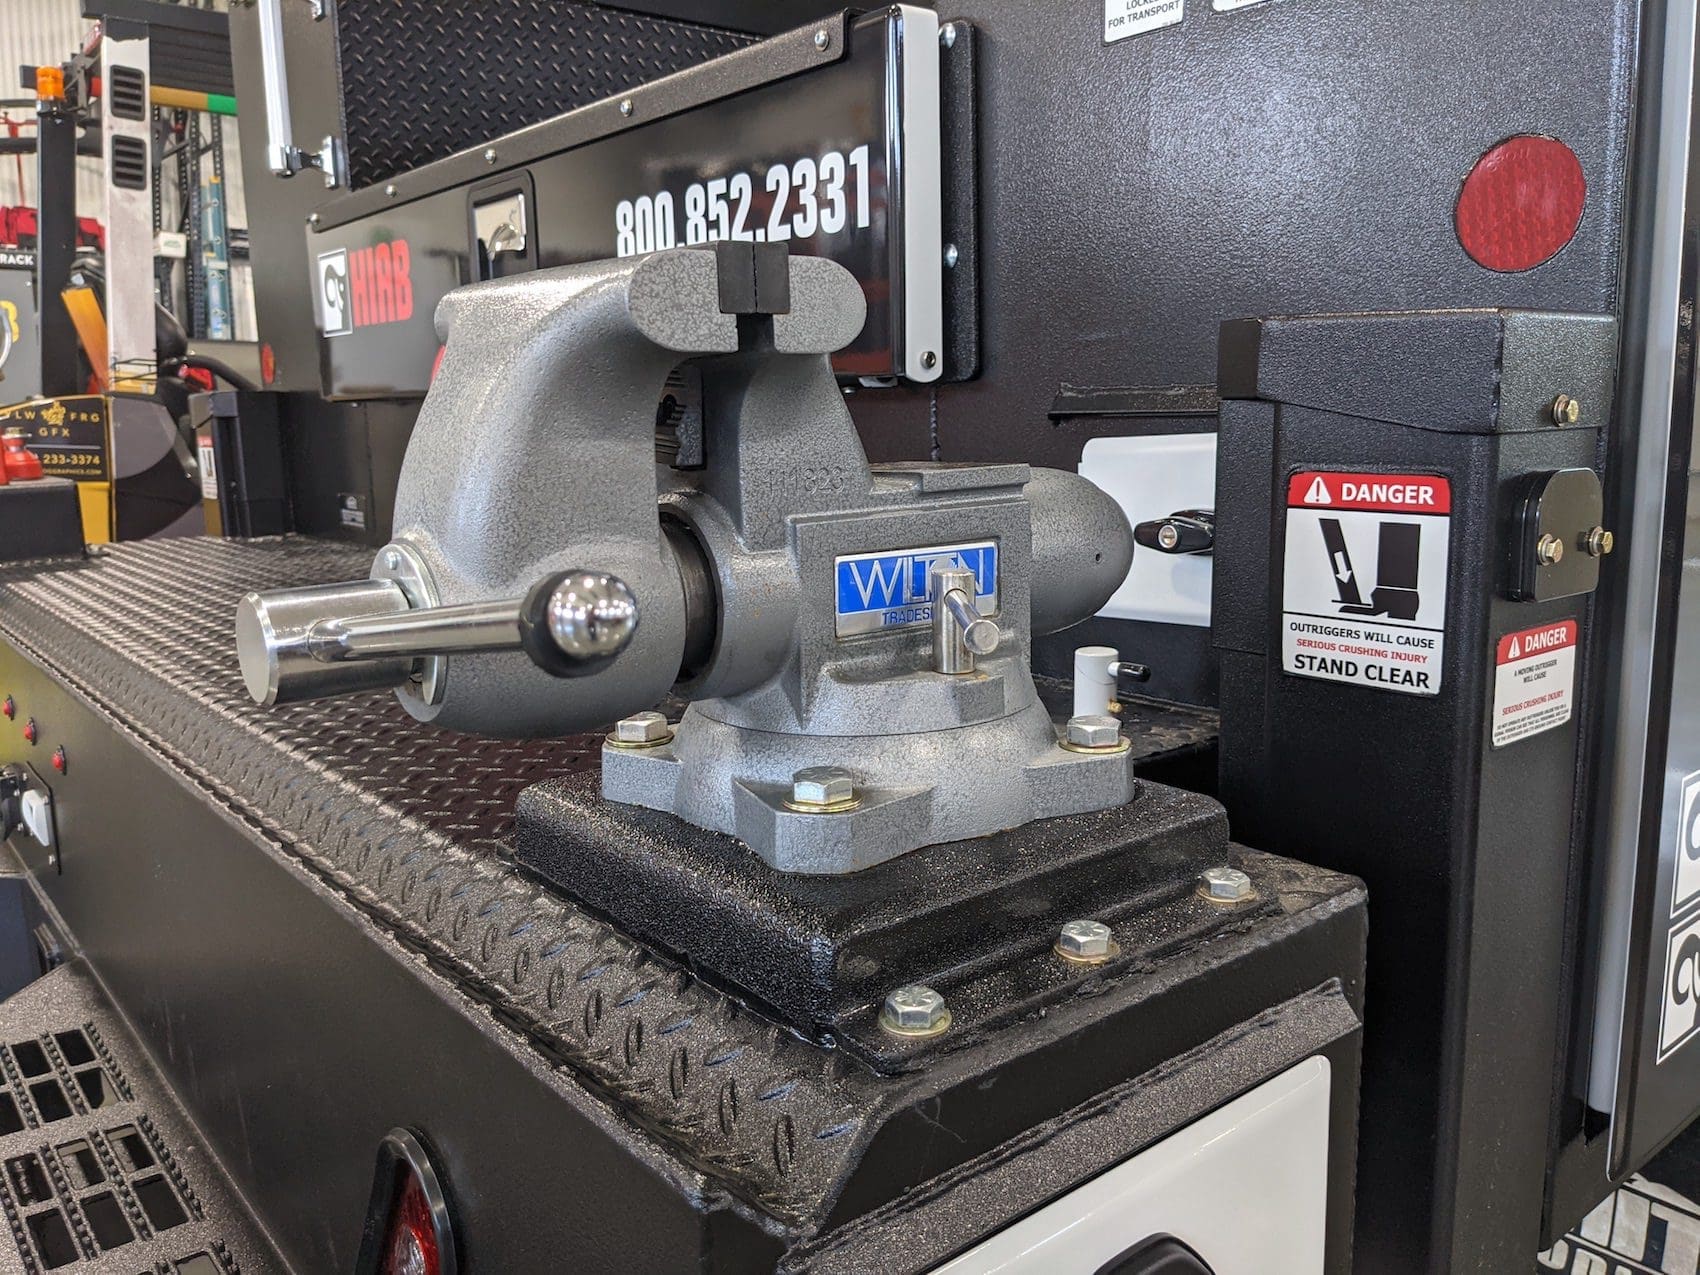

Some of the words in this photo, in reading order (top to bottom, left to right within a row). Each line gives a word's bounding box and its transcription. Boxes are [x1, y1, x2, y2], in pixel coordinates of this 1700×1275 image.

[1108, 16, 1125, 28] FOR
[1127, 1, 1179, 22] TRANSPORT
[349, 239, 413, 327] HIAB
[1341, 482, 1434, 505] DANGER
[849, 549, 984, 609] WILTN
[882, 606, 933, 625] TRADES
[1290, 622, 1361, 640] OUTRIGGERS
[1364, 631, 1393, 644] WILL
[1396, 635, 1435, 649] CAUSE
[1524, 627, 1567, 652] DANGER
[1296, 638, 1336, 651] SERIOUS
[1338, 644, 1388, 659] CRUSHING
[1391, 651, 1428, 664] INJURY
[1294, 654, 1358, 677] STAND
[1364, 664, 1430, 689] CLEAR
[1502, 702, 1523, 715] SERIOUS
[1523, 695, 1547, 709] CRUSHING
